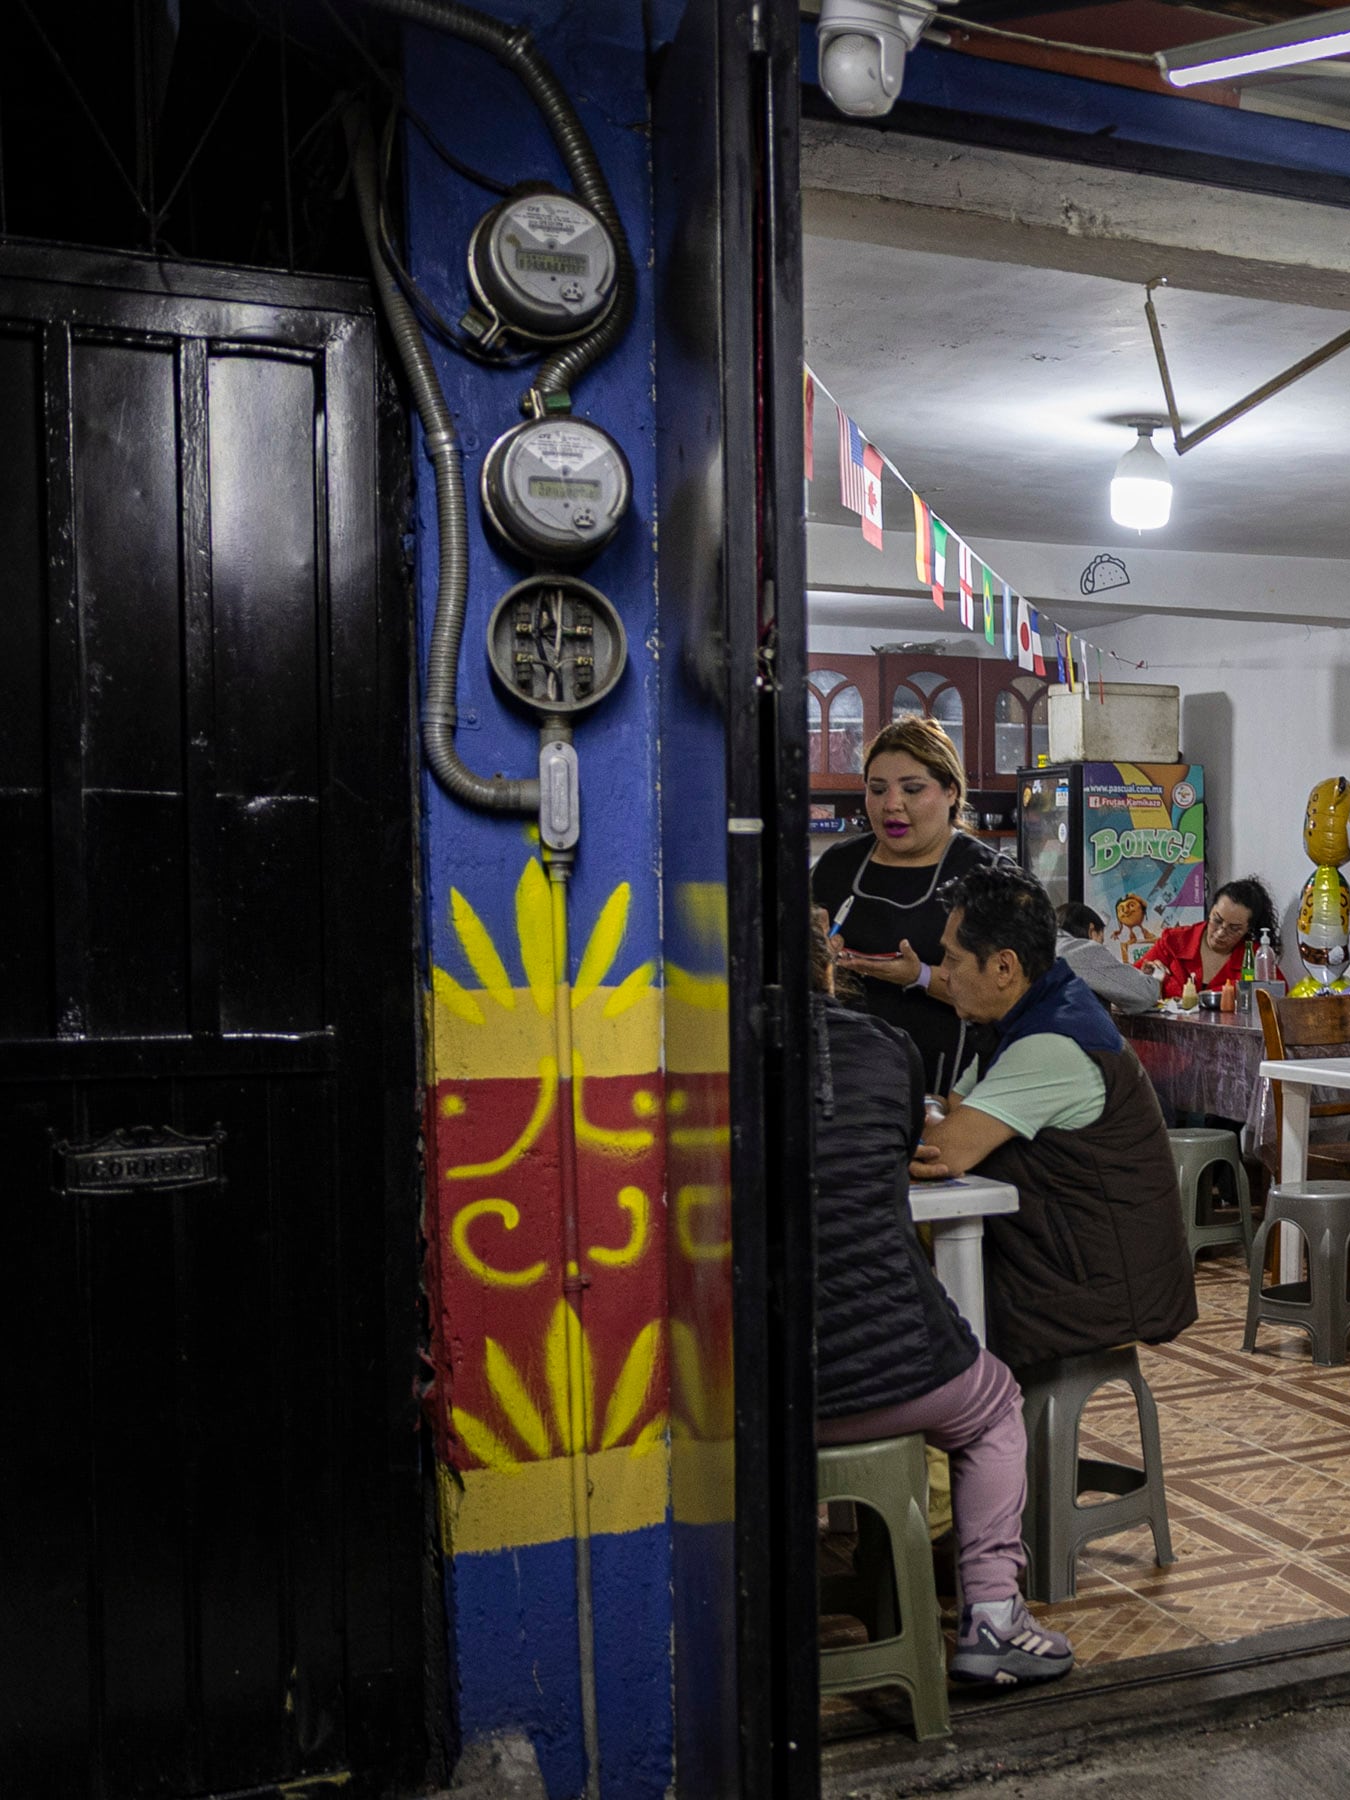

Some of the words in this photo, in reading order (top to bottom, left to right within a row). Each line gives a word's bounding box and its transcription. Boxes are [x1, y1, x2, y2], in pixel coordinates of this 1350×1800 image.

[1089, 785, 1163, 794] www.pascual.com.mx
[1090, 829, 1196, 875] BOING!
[90, 1153, 193, 1177] CORREO
